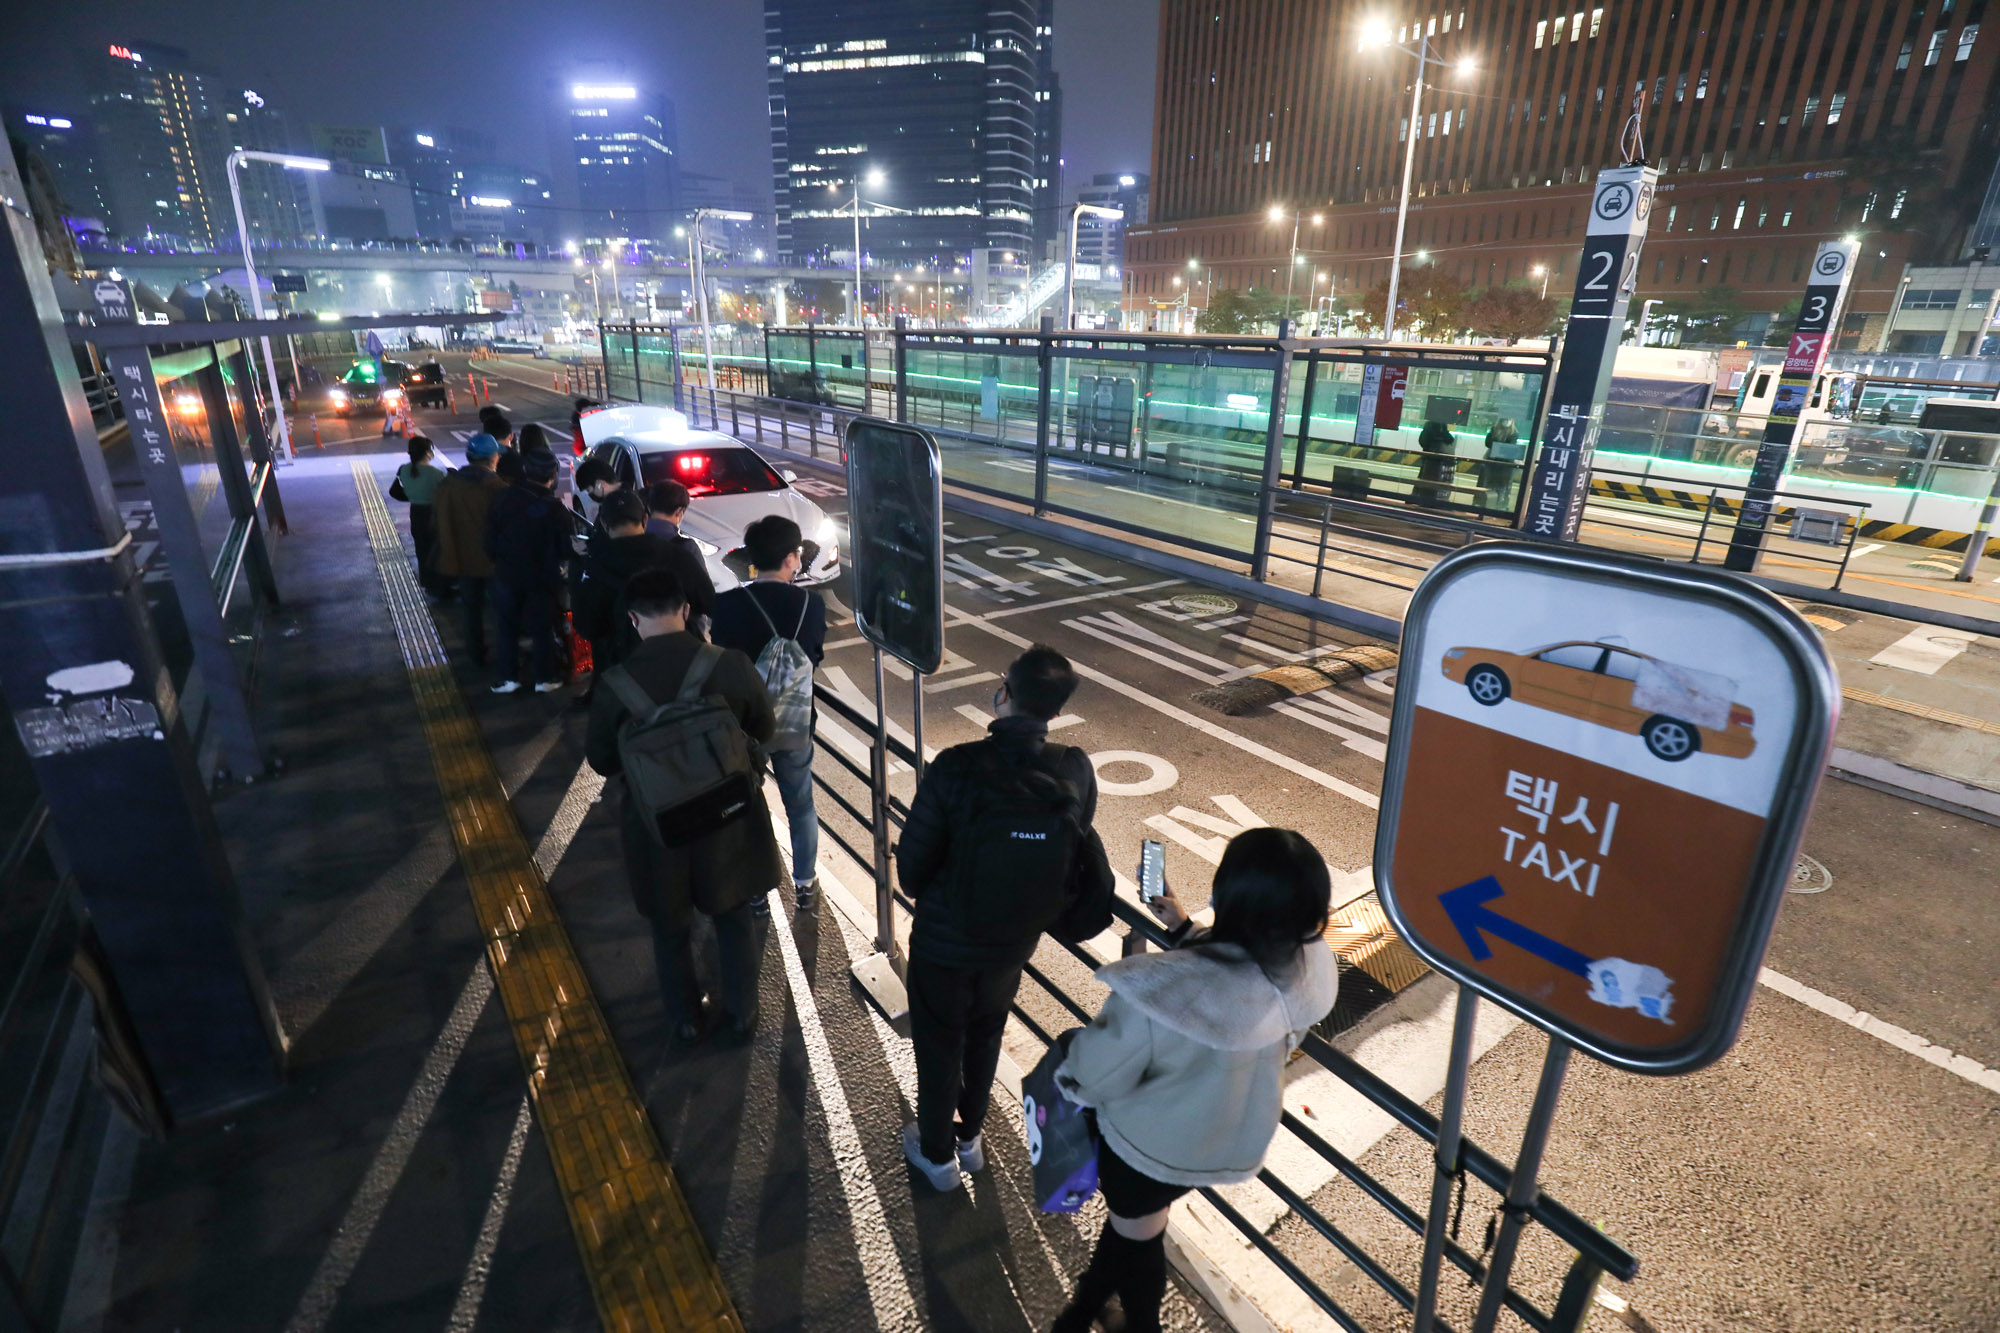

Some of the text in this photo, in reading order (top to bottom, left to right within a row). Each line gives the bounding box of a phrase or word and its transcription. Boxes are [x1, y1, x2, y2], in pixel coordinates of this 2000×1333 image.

[109, 44, 132, 60] AIA
[1583, 251, 1614, 290] 2
[102, 306, 129, 319] TAXI
[1803, 296, 1828, 322] 3
[1786, 358, 1814, 367] 공항버스
[122, 365, 166, 465] 택시타는곳
[1535, 404, 1580, 535] 택시내리는곳
[1504, 768, 1620, 857] 택시
[1018, 832, 1046, 840] GALXE
[1499, 826, 1601, 898] TAXI
